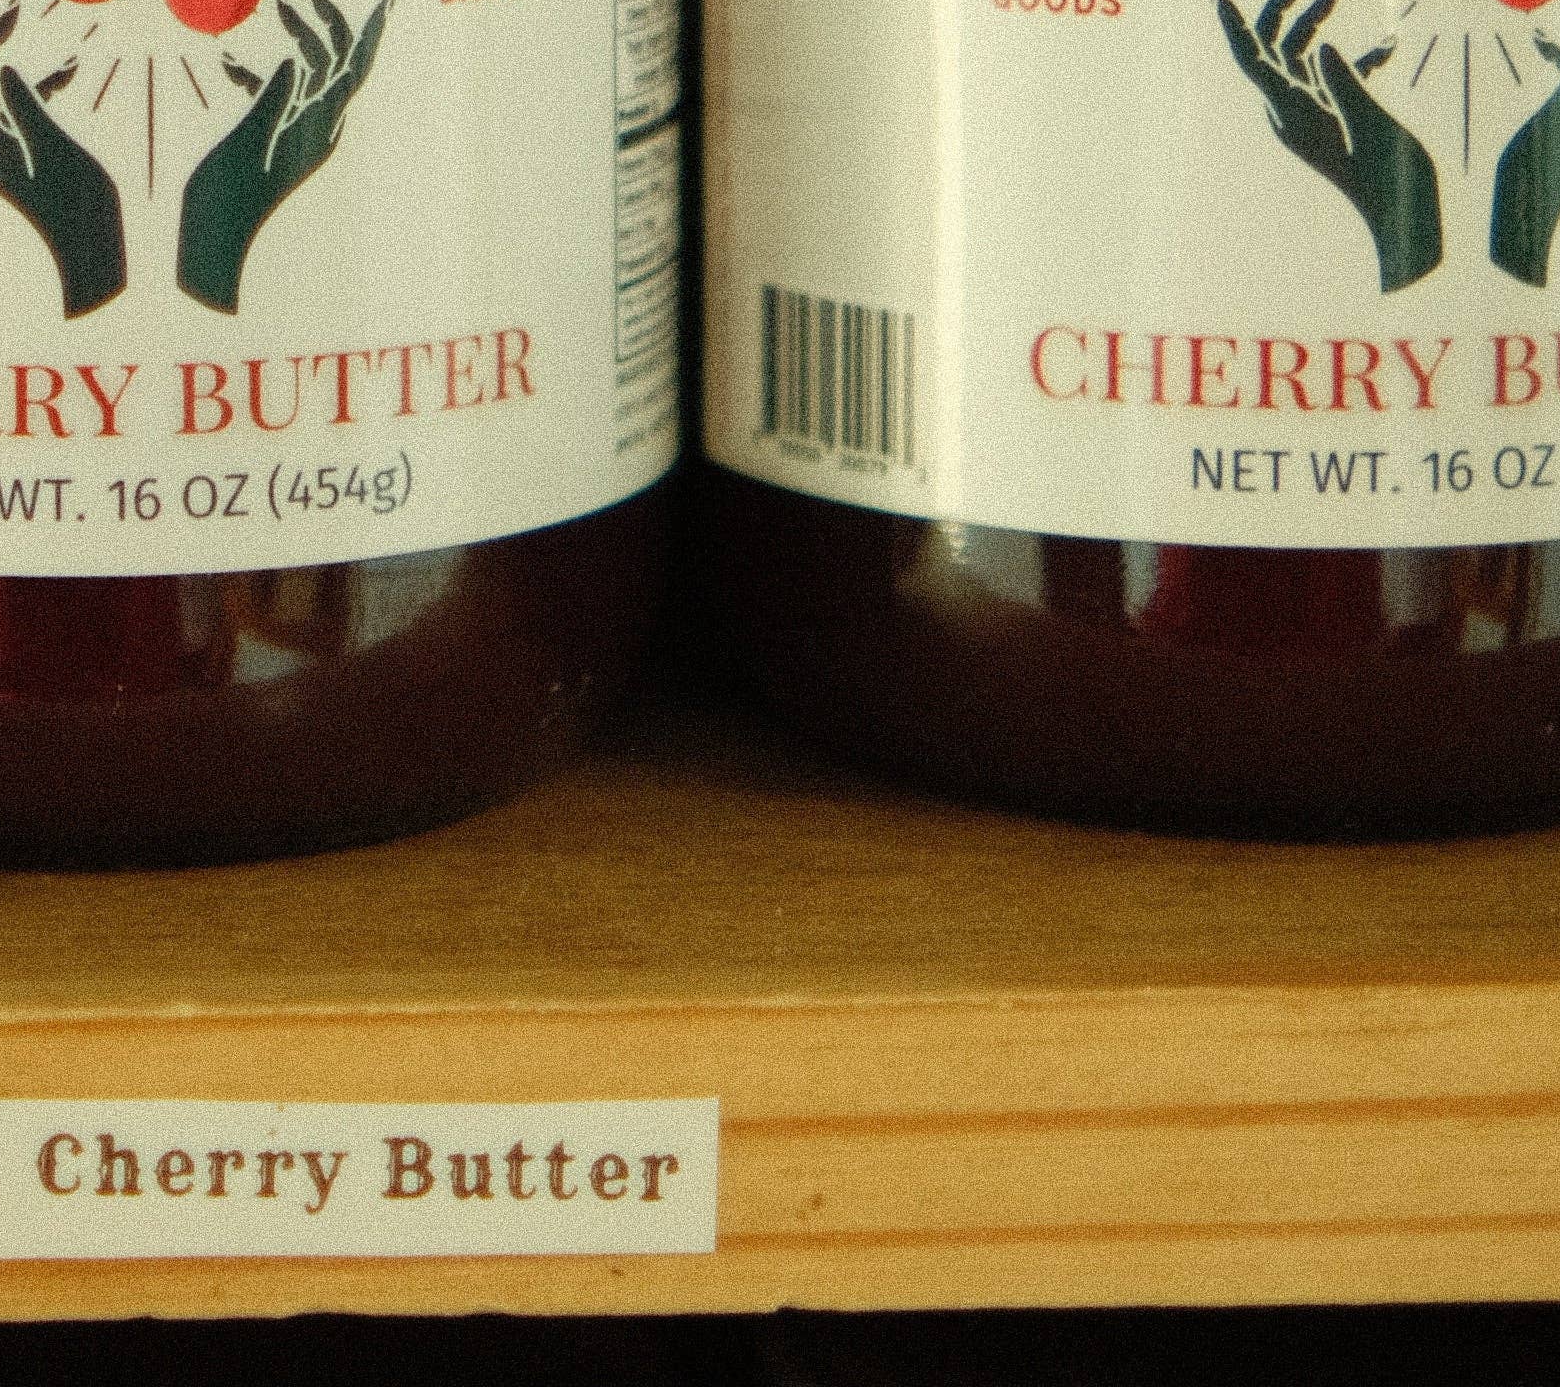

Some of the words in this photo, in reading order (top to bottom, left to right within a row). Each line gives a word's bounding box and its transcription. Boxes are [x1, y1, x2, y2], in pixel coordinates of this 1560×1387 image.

[174, 326, 539, 437] BUTTER
[1028, 325, 1454, 413] CHERRY
[108, 478, 163, 522] 16
[181, 474, 250, 519] OZ
[266, 454, 415, 520] (454g)
[1191, 445, 1290, 493] NET
[1309, 448, 1403, 495] WT.
[1422, 450, 1474, 493] 16
[1492, 443, 1556, 489] OZ
[36, 1131, 348, 1213] Cherry
[383, 1135, 680, 1204] Butter
